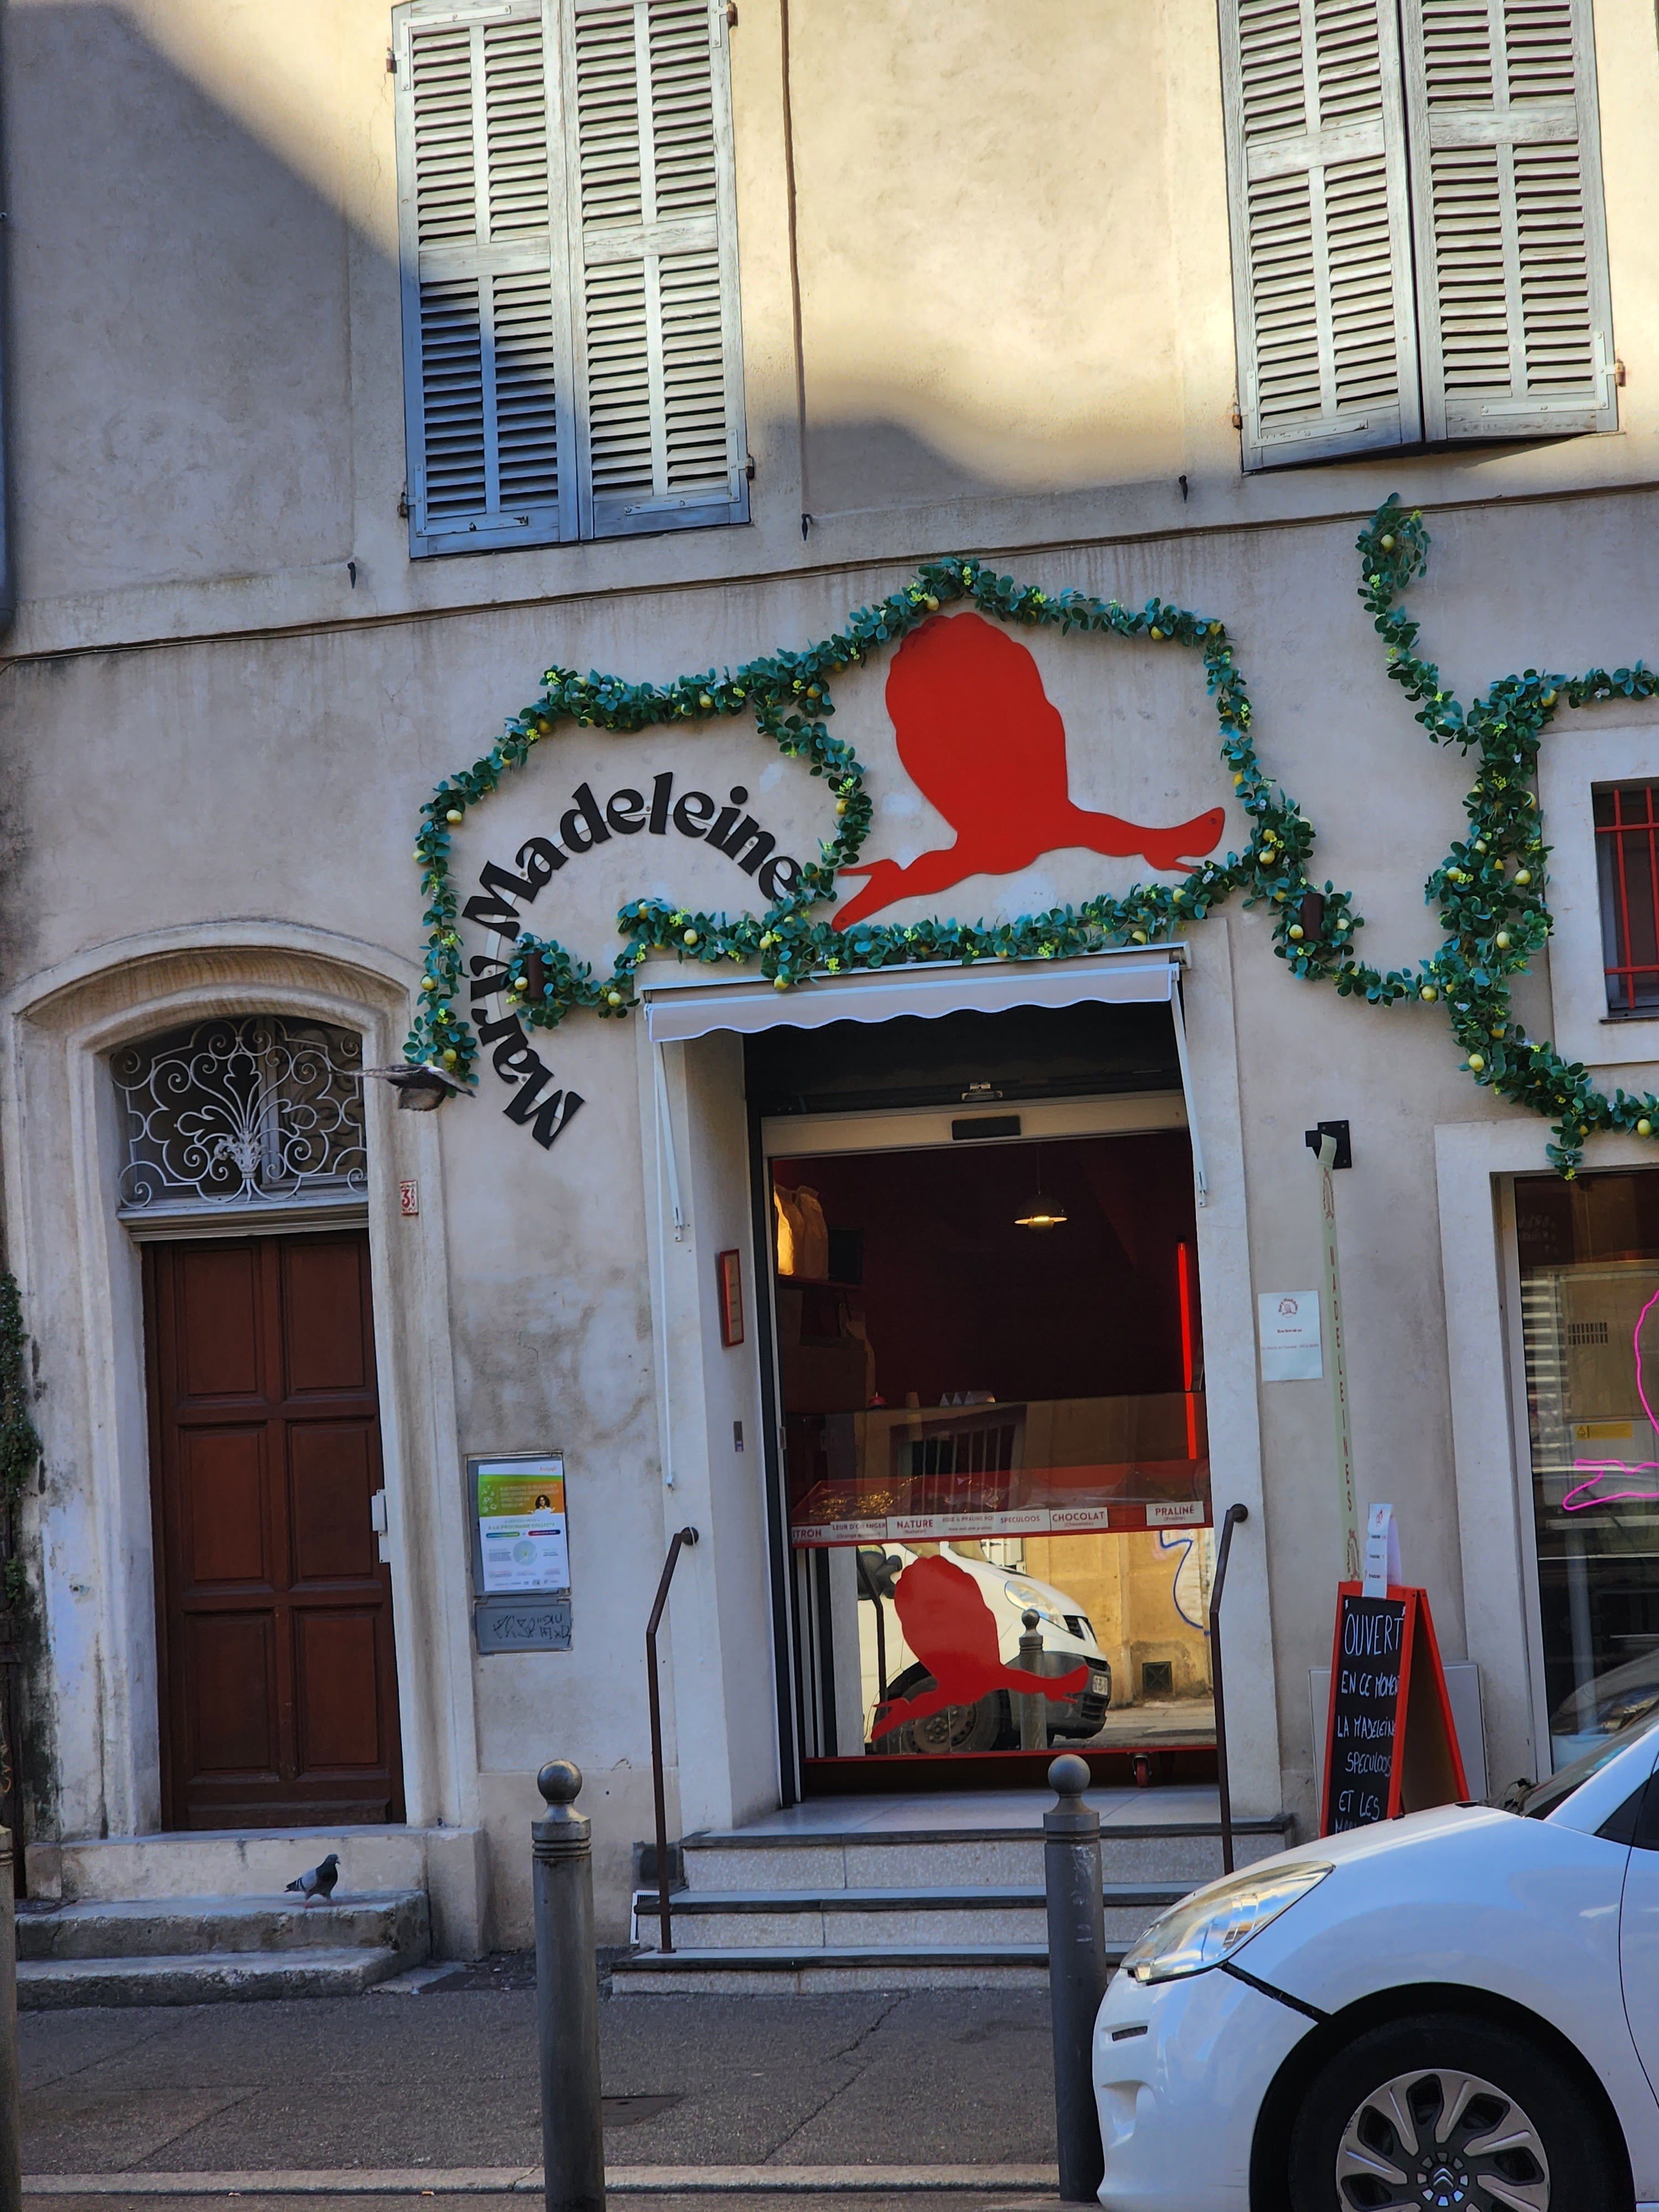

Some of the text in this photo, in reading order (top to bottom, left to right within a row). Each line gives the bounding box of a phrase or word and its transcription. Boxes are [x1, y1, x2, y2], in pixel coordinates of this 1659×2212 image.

[462, 771, 802, 940] Madeleine
[401, 1188, 415, 1208] 36
[1052, 1511, 1105, 1522] CHOCOLAT
[1155, 1504, 1194, 1516] PRALINÉ
[896, 1520, 933, 1528] NATURE
[1344, 1614, 1404, 1656] OUVERT
[1341, 1670, 1400, 1699] EN CE MOMEN
[1337, 1715, 1349, 1738] LA
[1345, 1751, 1392, 1777] SPECULOOS
[1339, 1790, 1380, 1821] ET LES
